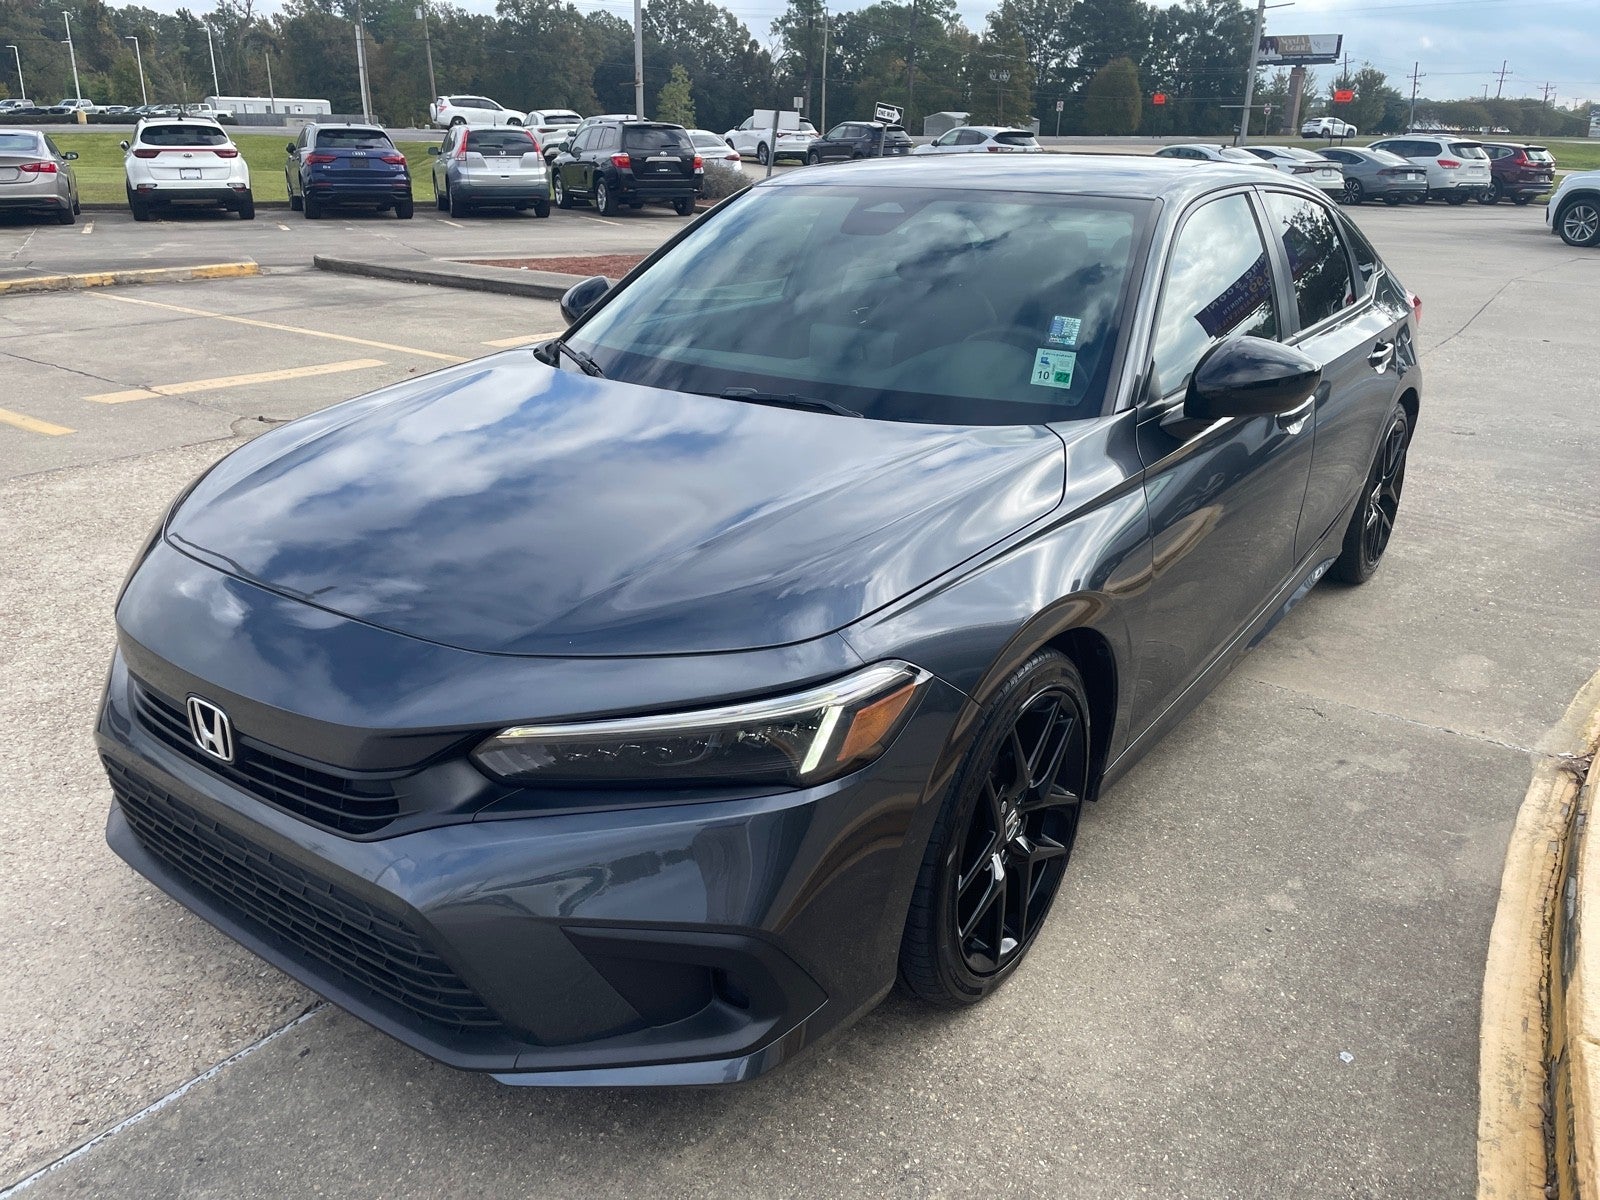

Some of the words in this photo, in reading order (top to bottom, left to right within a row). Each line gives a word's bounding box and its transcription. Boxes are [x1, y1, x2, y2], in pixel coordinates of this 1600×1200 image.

[878, 109, 886, 117] ONE
[887, 111, 895, 119] WAY
[1038, 370, 1050, 380] 10
[1056, 372, 1069, 382] 27
